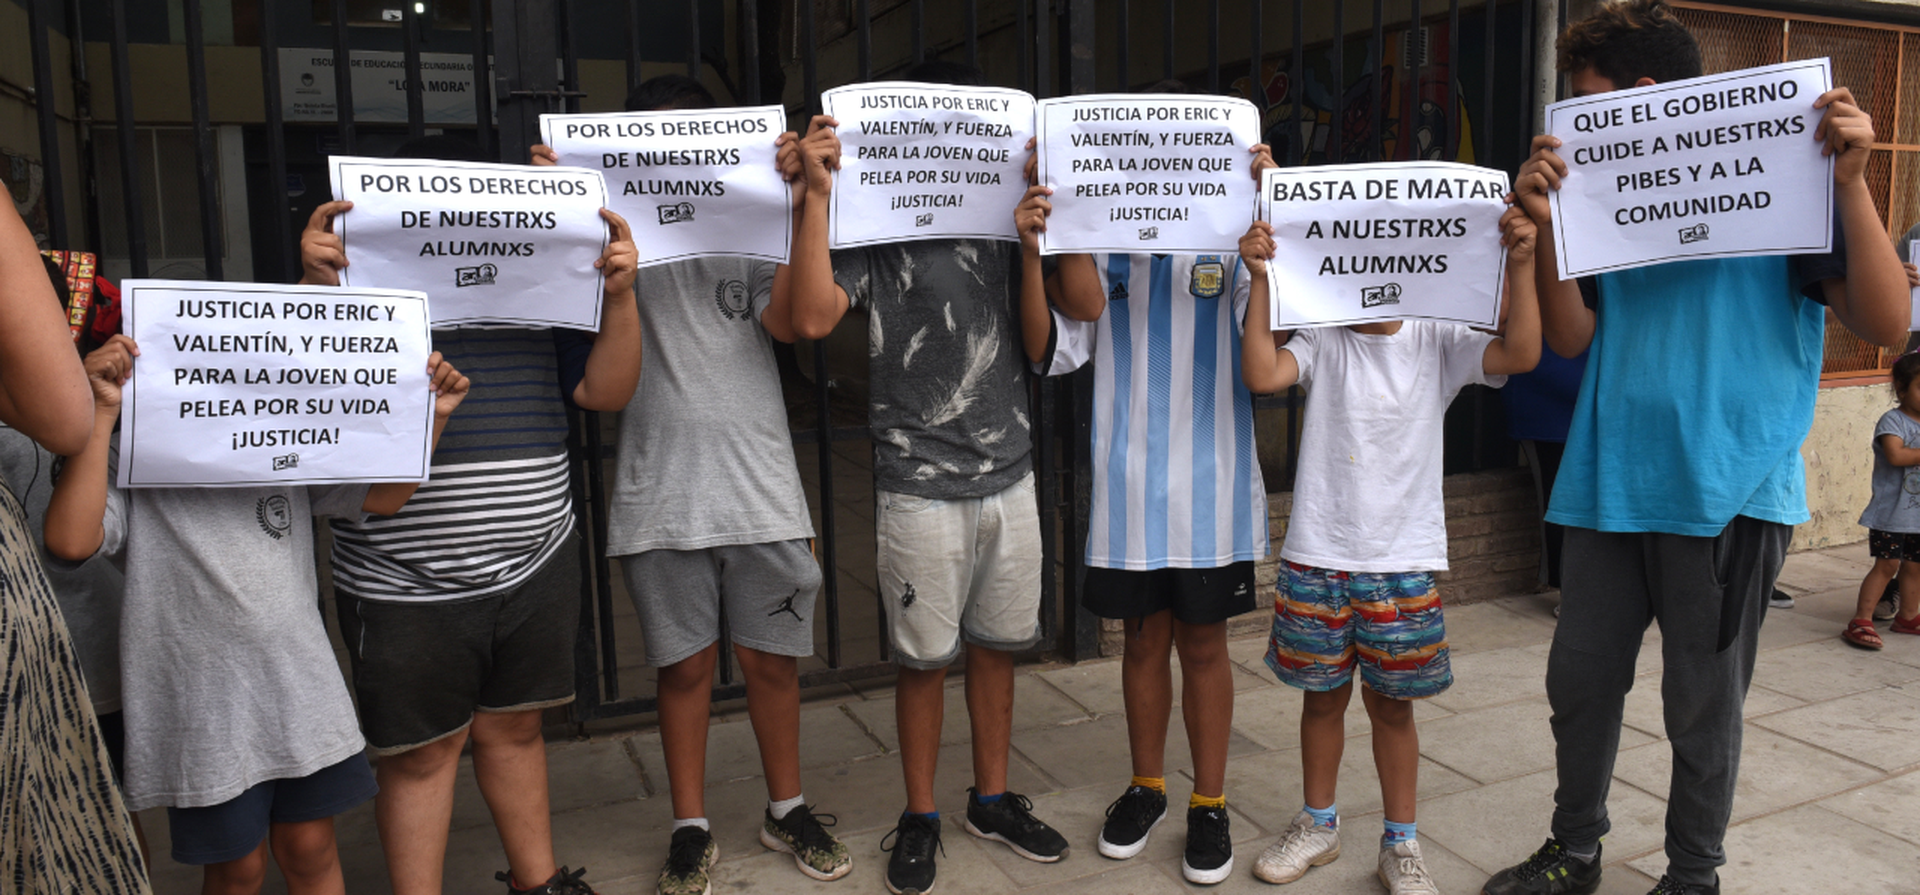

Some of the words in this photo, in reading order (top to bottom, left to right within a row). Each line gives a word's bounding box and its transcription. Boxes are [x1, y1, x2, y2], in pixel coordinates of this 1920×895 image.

[364, 59, 406, 69] EDUCACIÓ
[420, 61, 465, 71] ECUNDARIA
[861, 96, 928, 108] JUSTICIA
[933, 97, 963, 109] POR
[967, 99, 998, 111] ERIC
[1002, 100, 1009, 111] Y
[1574, 108, 1623, 133] QUE
[1632, 103, 1657, 123] EL
[1663, 79, 1799, 118] GOBIERNO
[1073, 108, 1141, 121] JUSTICIA
[1147, 107, 1179, 120] POR
[1185, 108, 1218, 120] ERIC
[1223, 109, 1231, 120] Y
[567, 124, 610, 138] POR
[617, 123, 654, 137] LOS
[662, 118, 767, 135] DERECHOS
[861, 118, 938, 137] VALENTÍN,
[944, 121, 953, 134] Y
[956, 121, 1013, 138] FUERZA
[1071, 130, 1154, 148] VALENTÍN,
[1159, 133, 1169, 146] Y
[1174, 132, 1234, 146] FUERZA
[1574, 140, 1644, 165] CUIDE
[1652, 137, 1669, 155] A
[1675, 115, 1805, 151] NUESTRXS
[602, 153, 629, 169] DE
[636, 148, 740, 167] NUESTRXS
[858, 146, 898, 159] PARA
[903, 146, 920, 159] LA
[924, 146, 973, 160] JOVEN
[977, 148, 1009, 163] QUE
[1073, 158, 1113, 172] PARA
[1119, 158, 1137, 170] LA
[1141, 158, 1193, 171] JOVEN
[1198, 157, 1232, 173] QUE
[1617, 168, 1681, 192] PIBES
[1687, 164, 1701, 182] Y
[1710, 162, 1727, 180] A
[1735, 157, 1764, 176] LA
[361, 175, 411, 192] POR
[419, 176, 462, 193] LOS
[469, 178, 587, 195] DERECHOS
[861, 171, 902, 185] PELEA
[907, 170, 936, 183] POR
[941, 170, 961, 183] SU
[966, 172, 1000, 185] VIDA
[623, 180, 725, 196] ALUMNXS
[1076, 183, 1121, 197] PELEA
[1126, 182, 1158, 195] POR
[1163, 183, 1183, 195] SU
[1188, 183, 1226, 196] VIDA
[1274, 181, 1356, 201] BASTA
[1366, 180, 1398, 200] DE
[1408, 178, 1507, 200] MATAR
[892, 194, 963, 210] ¡JUSTICIA!
[1615, 190, 1771, 226] COMUNIDAD
[402, 211, 431, 228] DE
[439, 211, 556, 229] NUESTRXS
[1110, 207, 1188, 221] ¡JUSTICIA!
[1305, 221, 1323, 239] A
[1332, 217, 1466, 239] NUESTRXS
[419, 241, 534, 257] ALUMNXS
[1319, 255, 1447, 276] ALUMNXS
[176, 300, 275, 319] JUSTICIA
[283, 303, 327, 320] POR
[334, 304, 378, 321] ERIC
[385, 306, 395, 321] Y
[173, 331, 293, 356] VALENTÍN,
[301, 336, 313, 352] Y
[321, 336, 399, 353] FUERZA
[175, 368, 237, 385] PARA
[244, 369, 270, 384] LA
[276, 369, 346, 384] JOVEN
[354, 369, 396, 387] QUE
[180, 399, 246, 418] PELEA
[254, 399, 299, 415] POR
[306, 399, 333, 414] SU
[340, 399, 390, 414] VIDA
[233, 428, 339, 450] ¡JUSTICIA!
